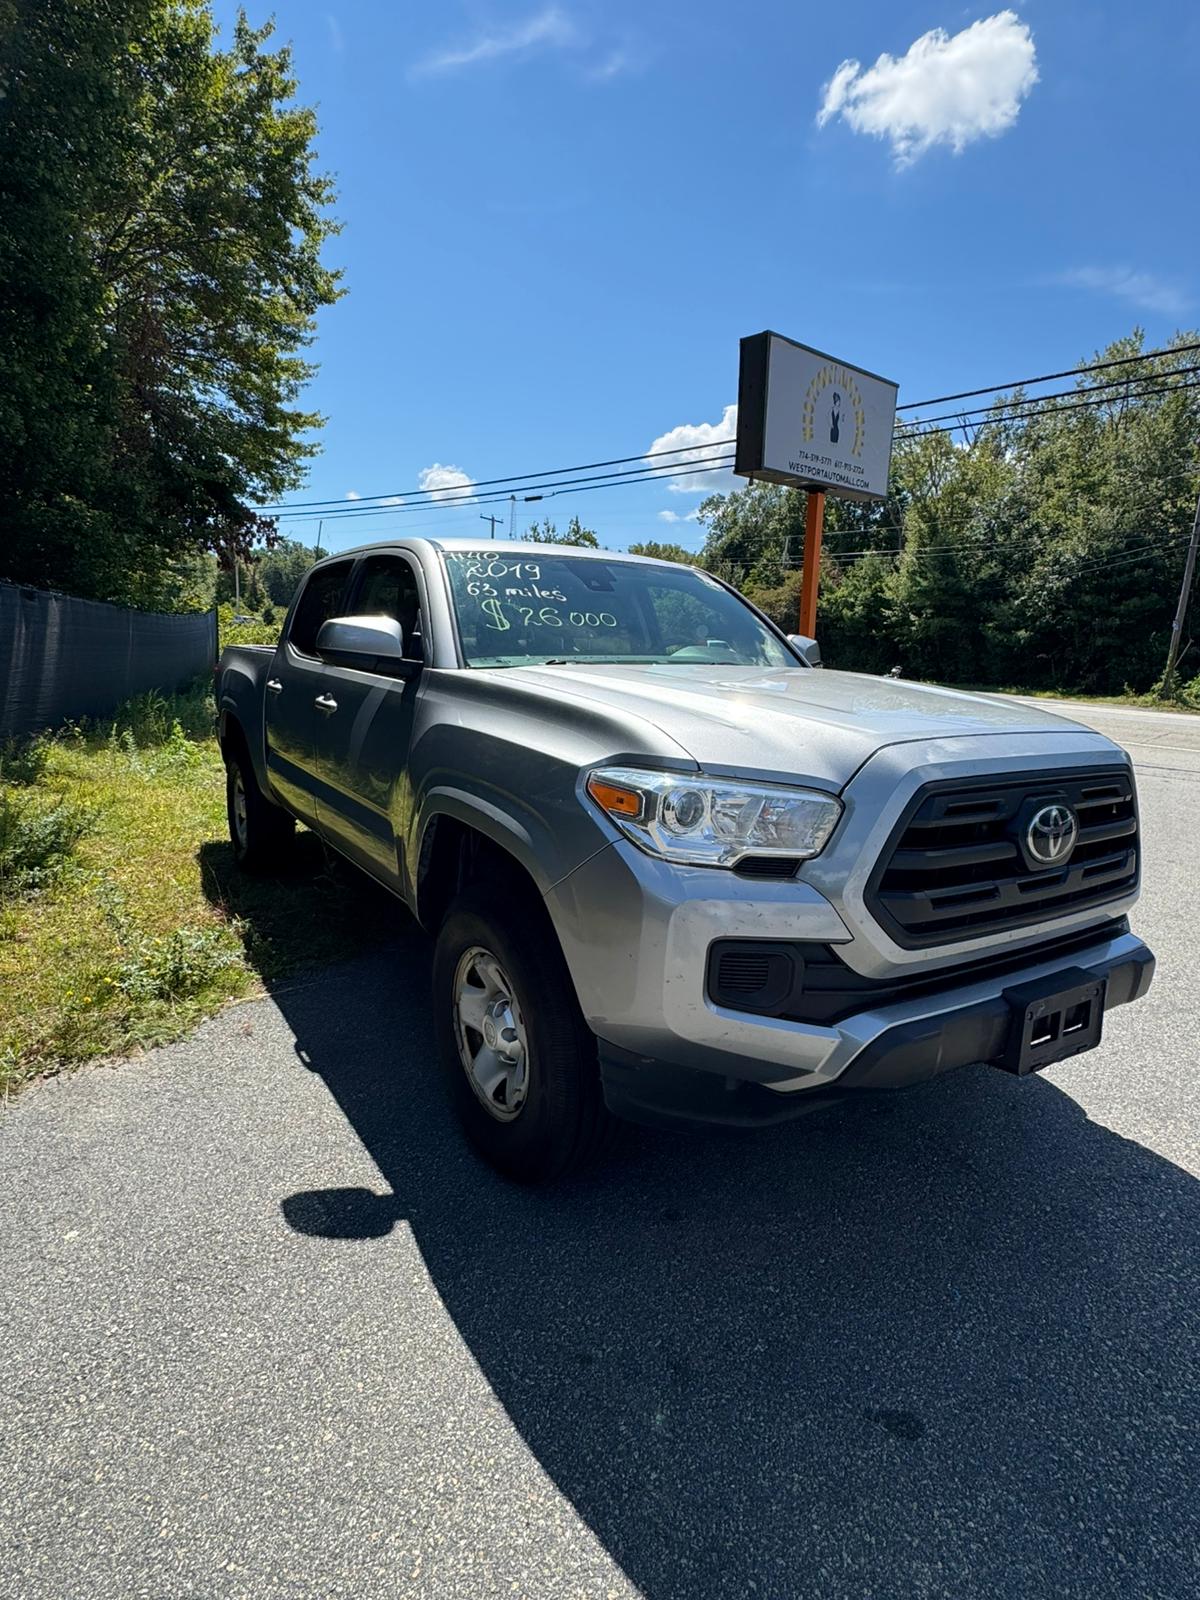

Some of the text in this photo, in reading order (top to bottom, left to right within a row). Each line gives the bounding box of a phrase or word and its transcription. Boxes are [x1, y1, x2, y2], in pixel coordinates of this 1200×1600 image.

[788, 461, 870, 489] WESTPORTAUTOMALL.COM
[466, 560, 541, 580] 2019
[467, 582, 568, 601] 63 miles
